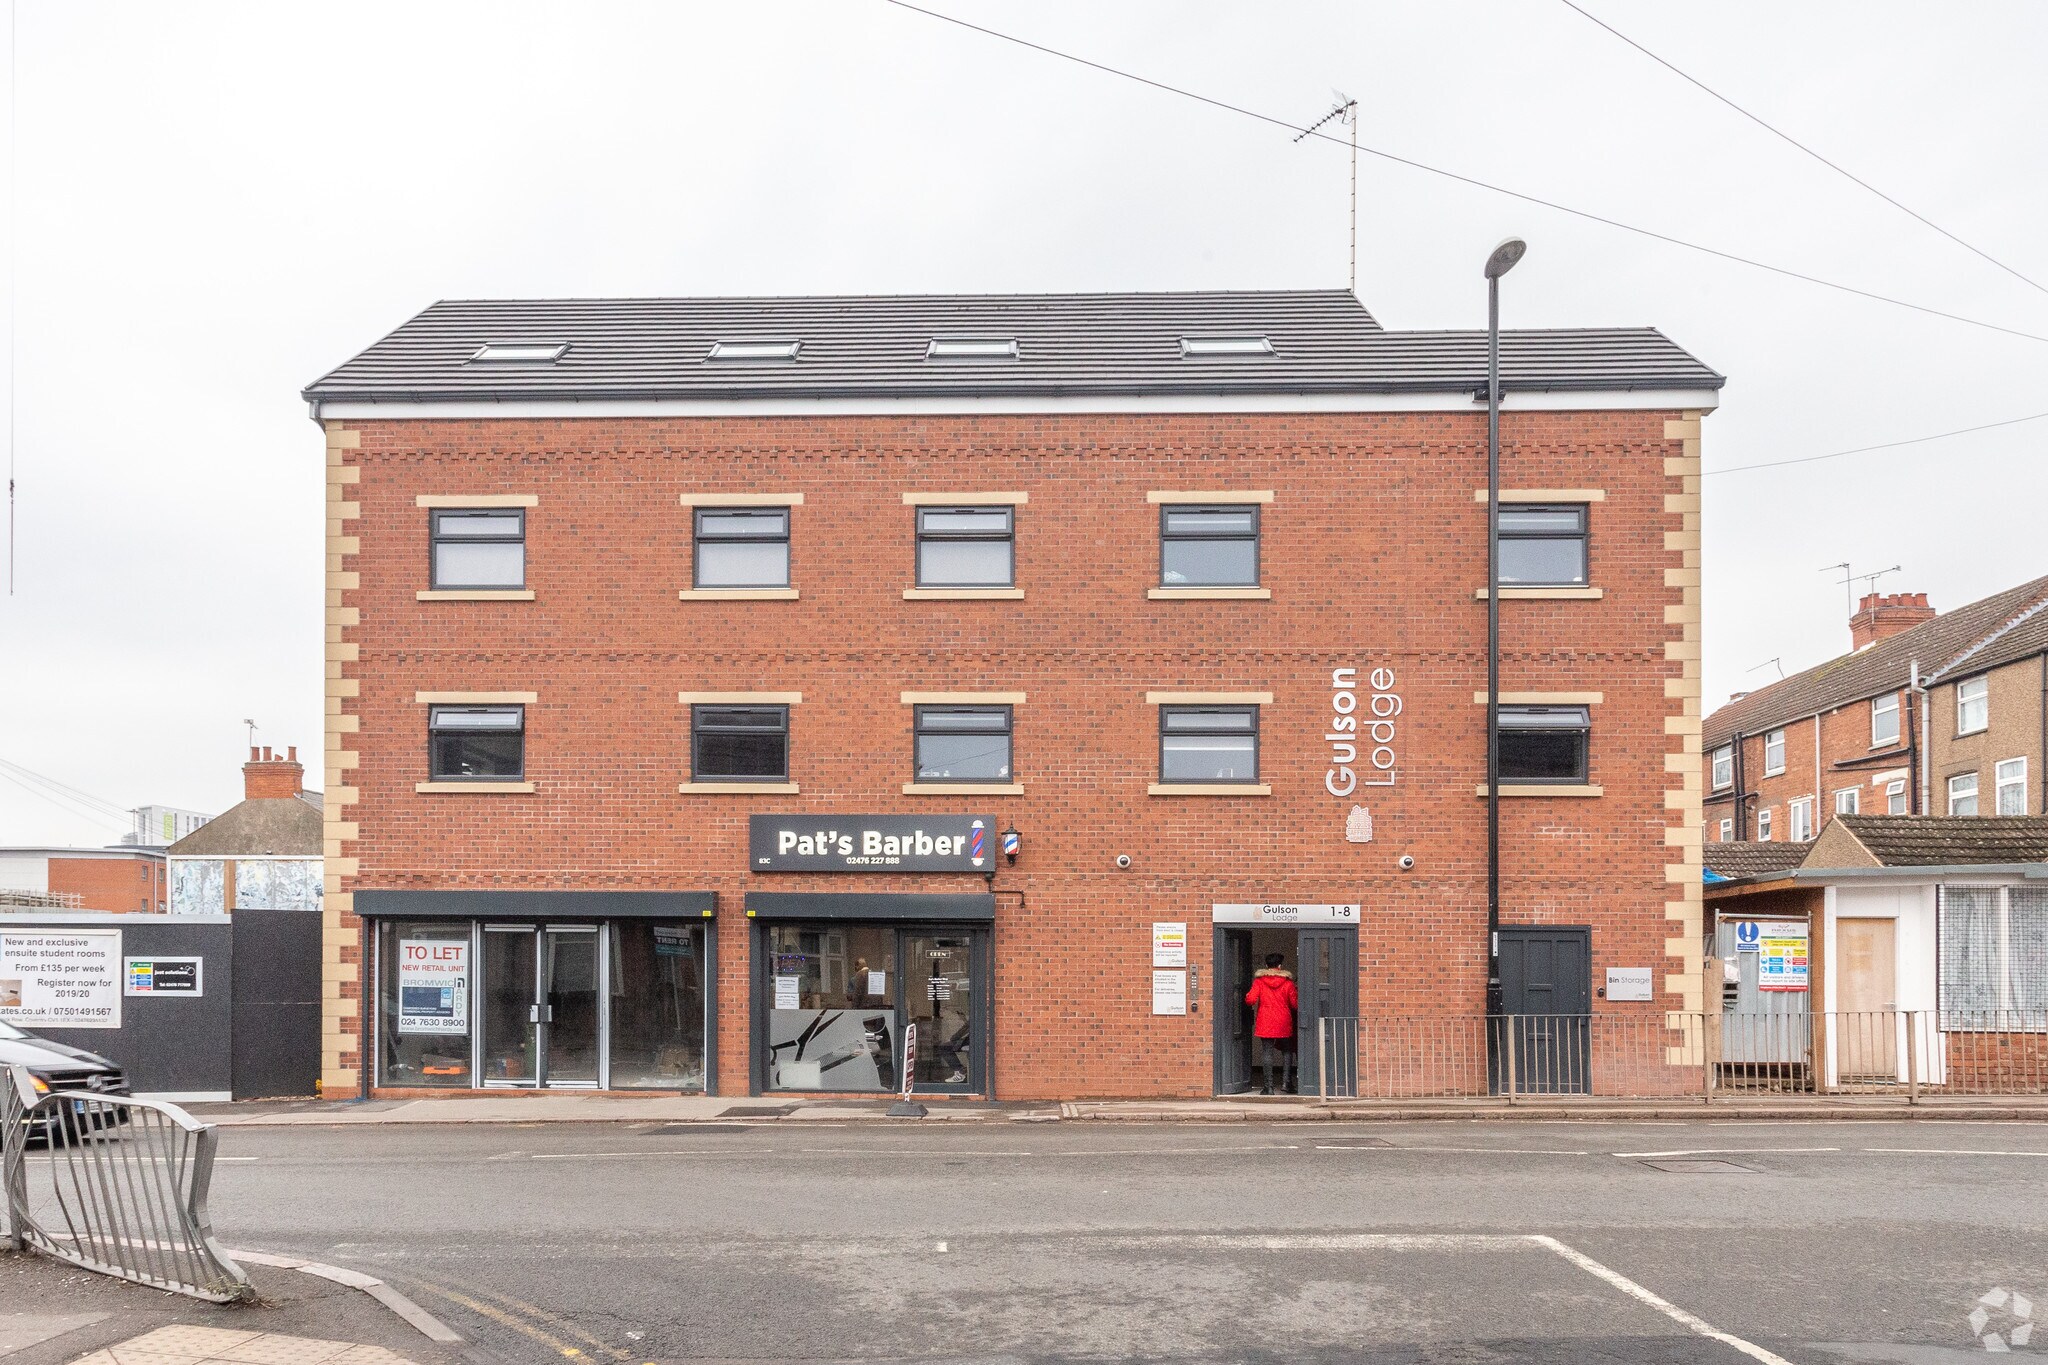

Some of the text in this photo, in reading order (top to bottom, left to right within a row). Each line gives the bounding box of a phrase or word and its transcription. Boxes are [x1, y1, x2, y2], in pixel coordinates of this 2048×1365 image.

[1325, 668, 1357, 797] Gulson
[1364, 668, 1403, 786] Lodge
[778, 830, 966, 856] Pat's Barber
[1263, 905, 1298, 914] Gulson
[1330, 906, 1350, 916] 1-8
[405, 946, 463, 960] TO LET
[37, 979, 75, 988] Register
